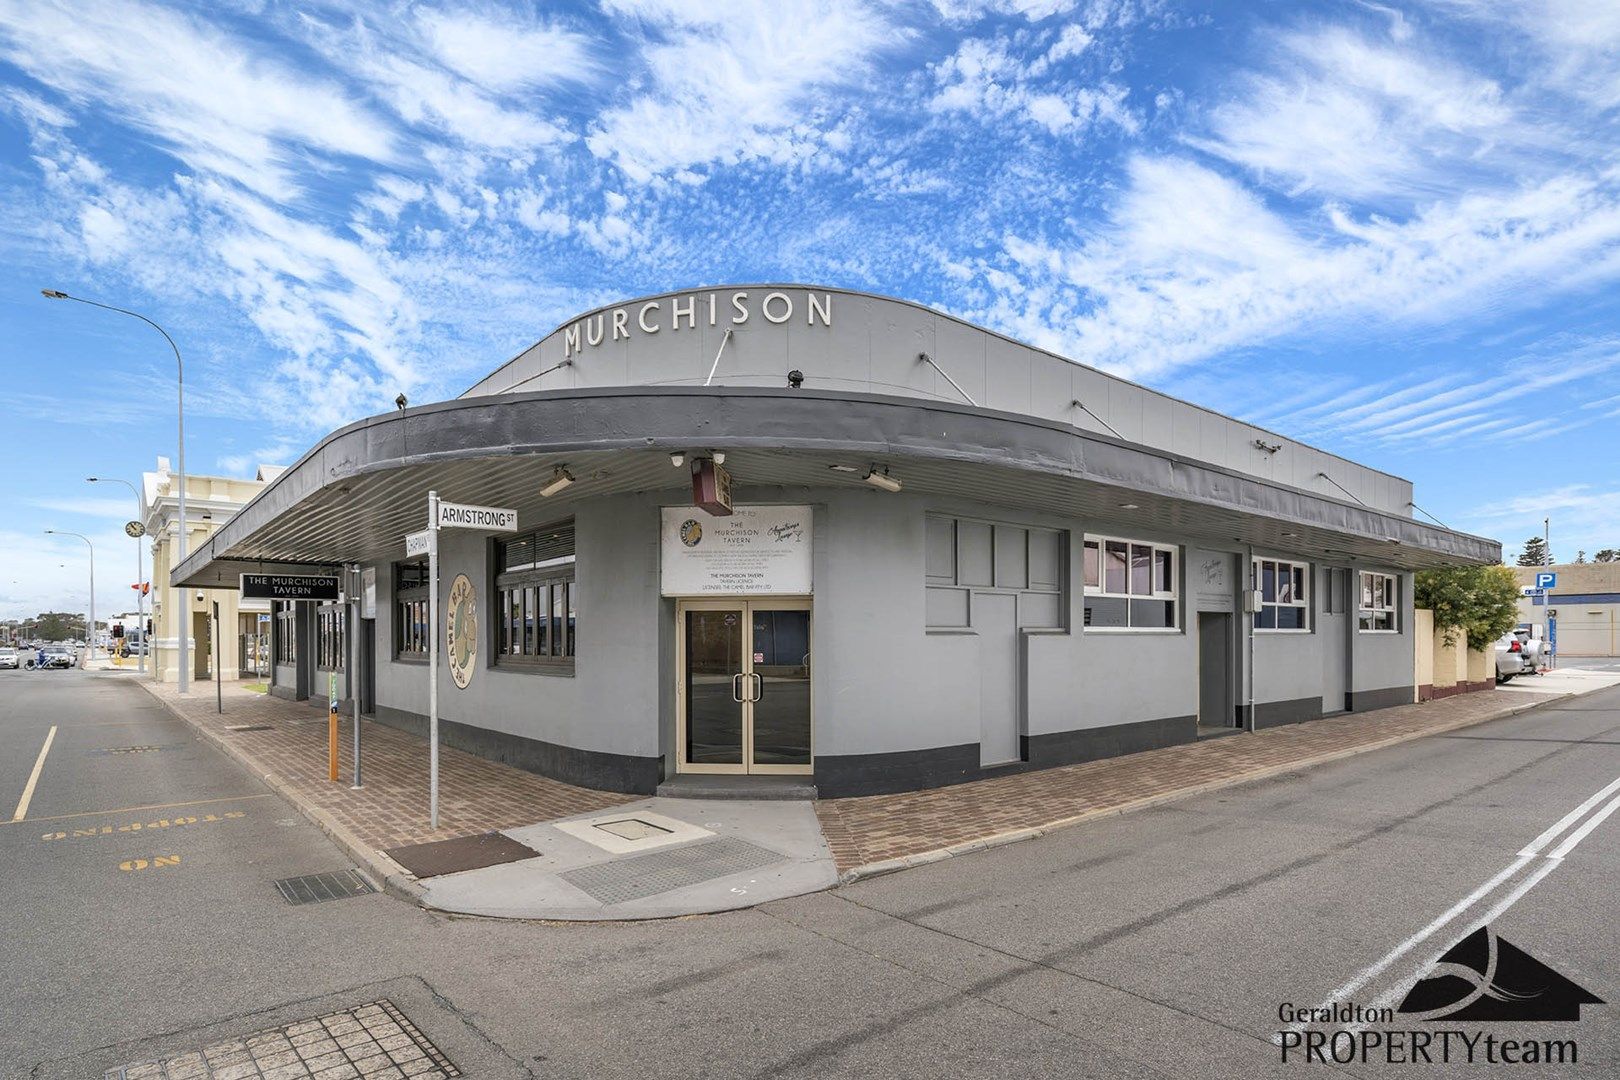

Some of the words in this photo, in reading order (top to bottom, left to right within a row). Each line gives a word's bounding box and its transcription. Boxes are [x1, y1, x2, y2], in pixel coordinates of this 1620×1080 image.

[564, 291, 833, 358] MURCHISON
[441, 507, 506, 527] ARMSTRONG
[507, 513, 515, 523] ST
[249, 576, 268, 585] THE
[272, 577, 334, 586] MURCHISON
[1539, 574, 1553, 587] P
[273, 586, 312, 595] TAVERN
